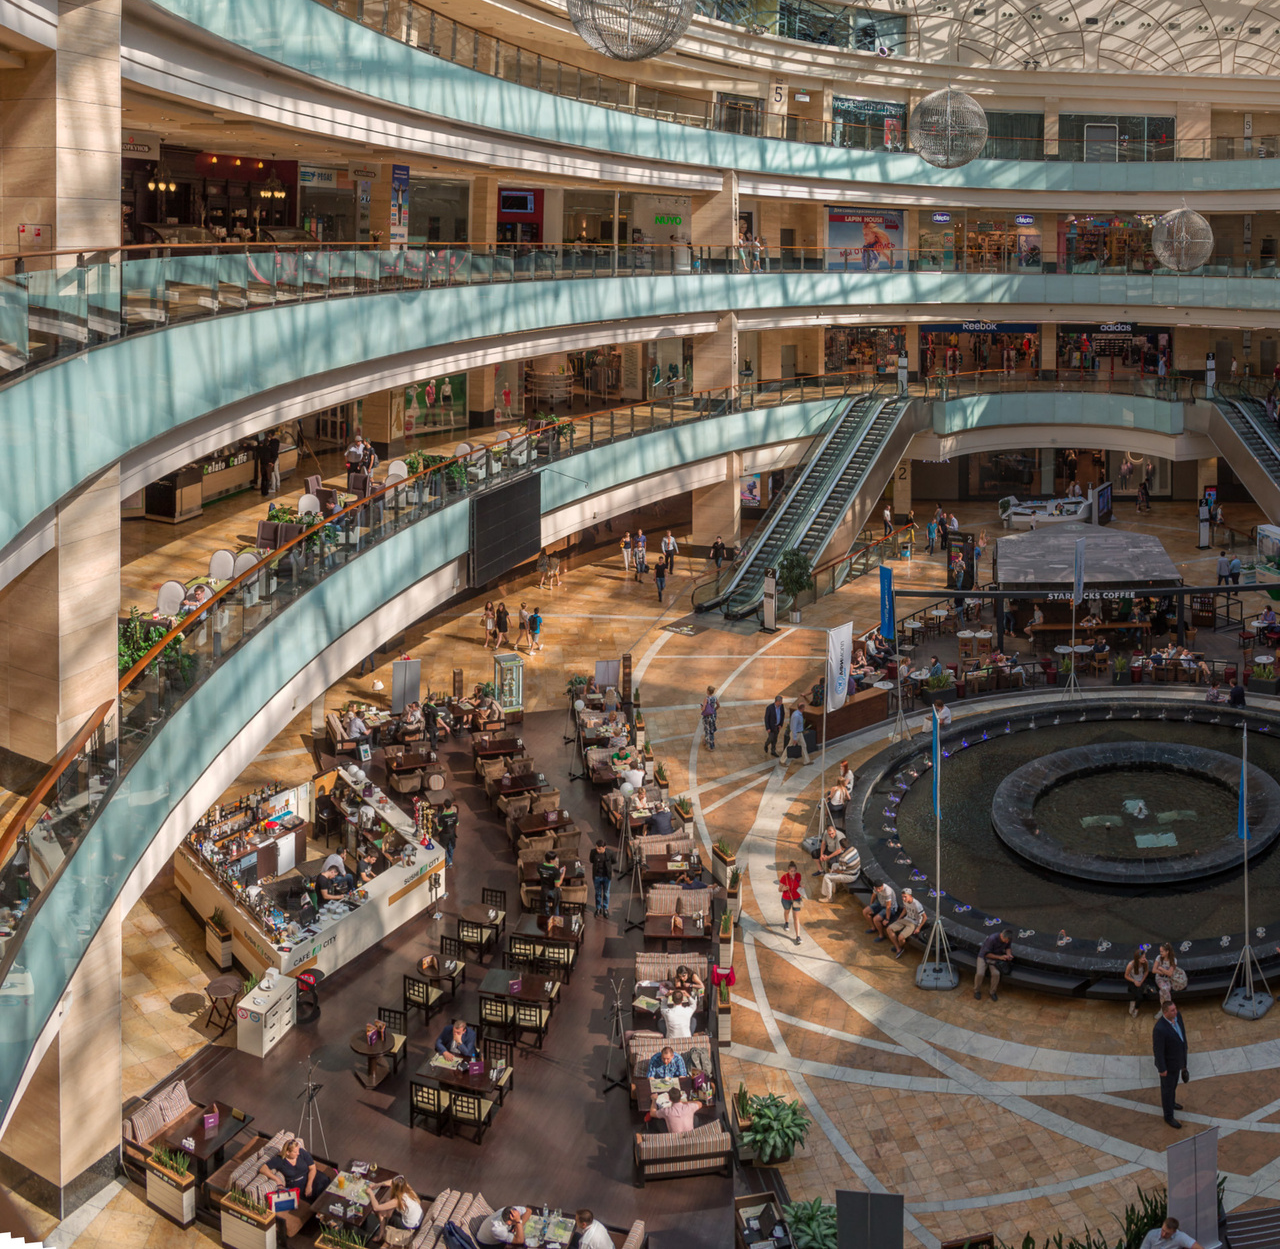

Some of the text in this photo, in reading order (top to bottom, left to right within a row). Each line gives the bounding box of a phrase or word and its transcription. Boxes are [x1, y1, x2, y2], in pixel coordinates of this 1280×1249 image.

[774, 86, 782, 102] 5
[1246, 120, 1251, 130] 5
[962, 322, 997, 330] Reebok
[1100, 323, 1131, 332] adidas
[203, 461, 226, 474] Gelato
[898, 468, 906, 479] 2
[768, 569, 773, 577] 2
[404, 857, 440, 885] SUSHI CITY
[294, 935, 337, 966] CAFÉ CITY
